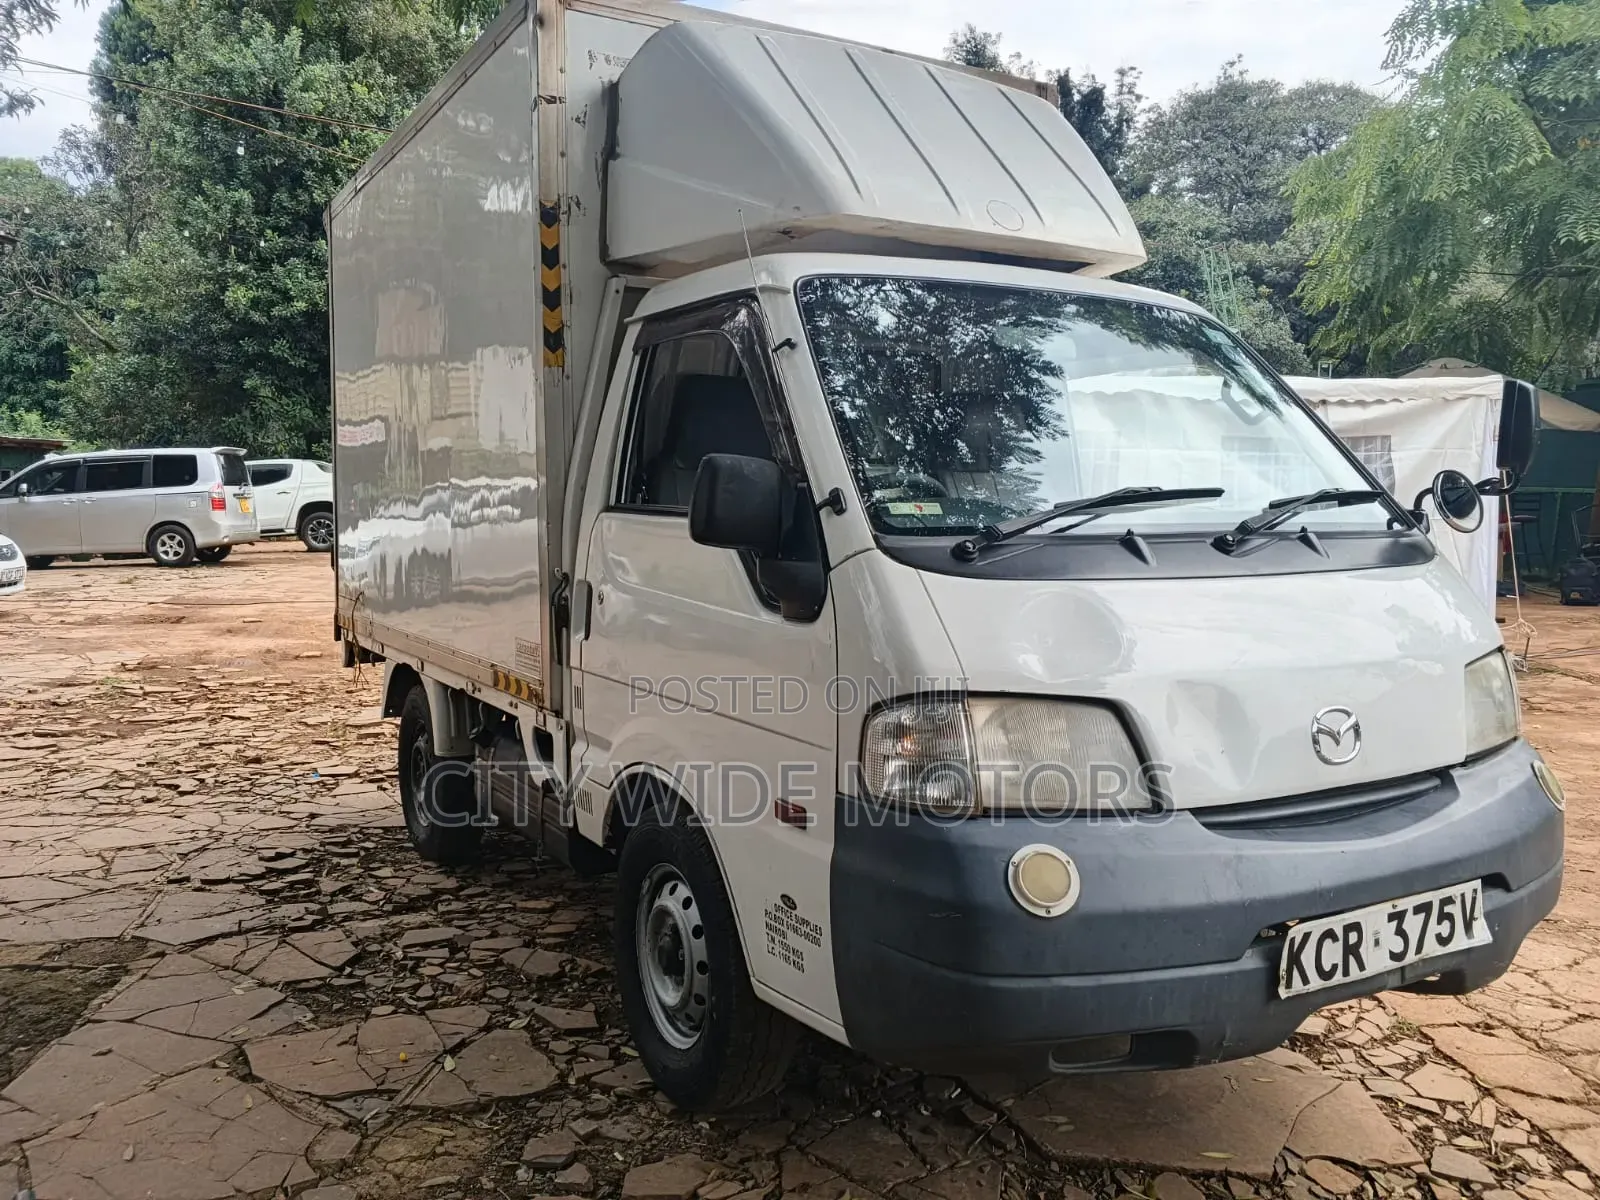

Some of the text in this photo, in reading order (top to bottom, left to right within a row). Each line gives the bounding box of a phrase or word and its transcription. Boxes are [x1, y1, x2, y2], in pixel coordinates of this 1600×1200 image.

[765, 921, 788, 941] NAIROBI
[774, 903, 823, 937] OFFICE SUPPLIES
[1285, 888, 1478, 990] KCR 375V
